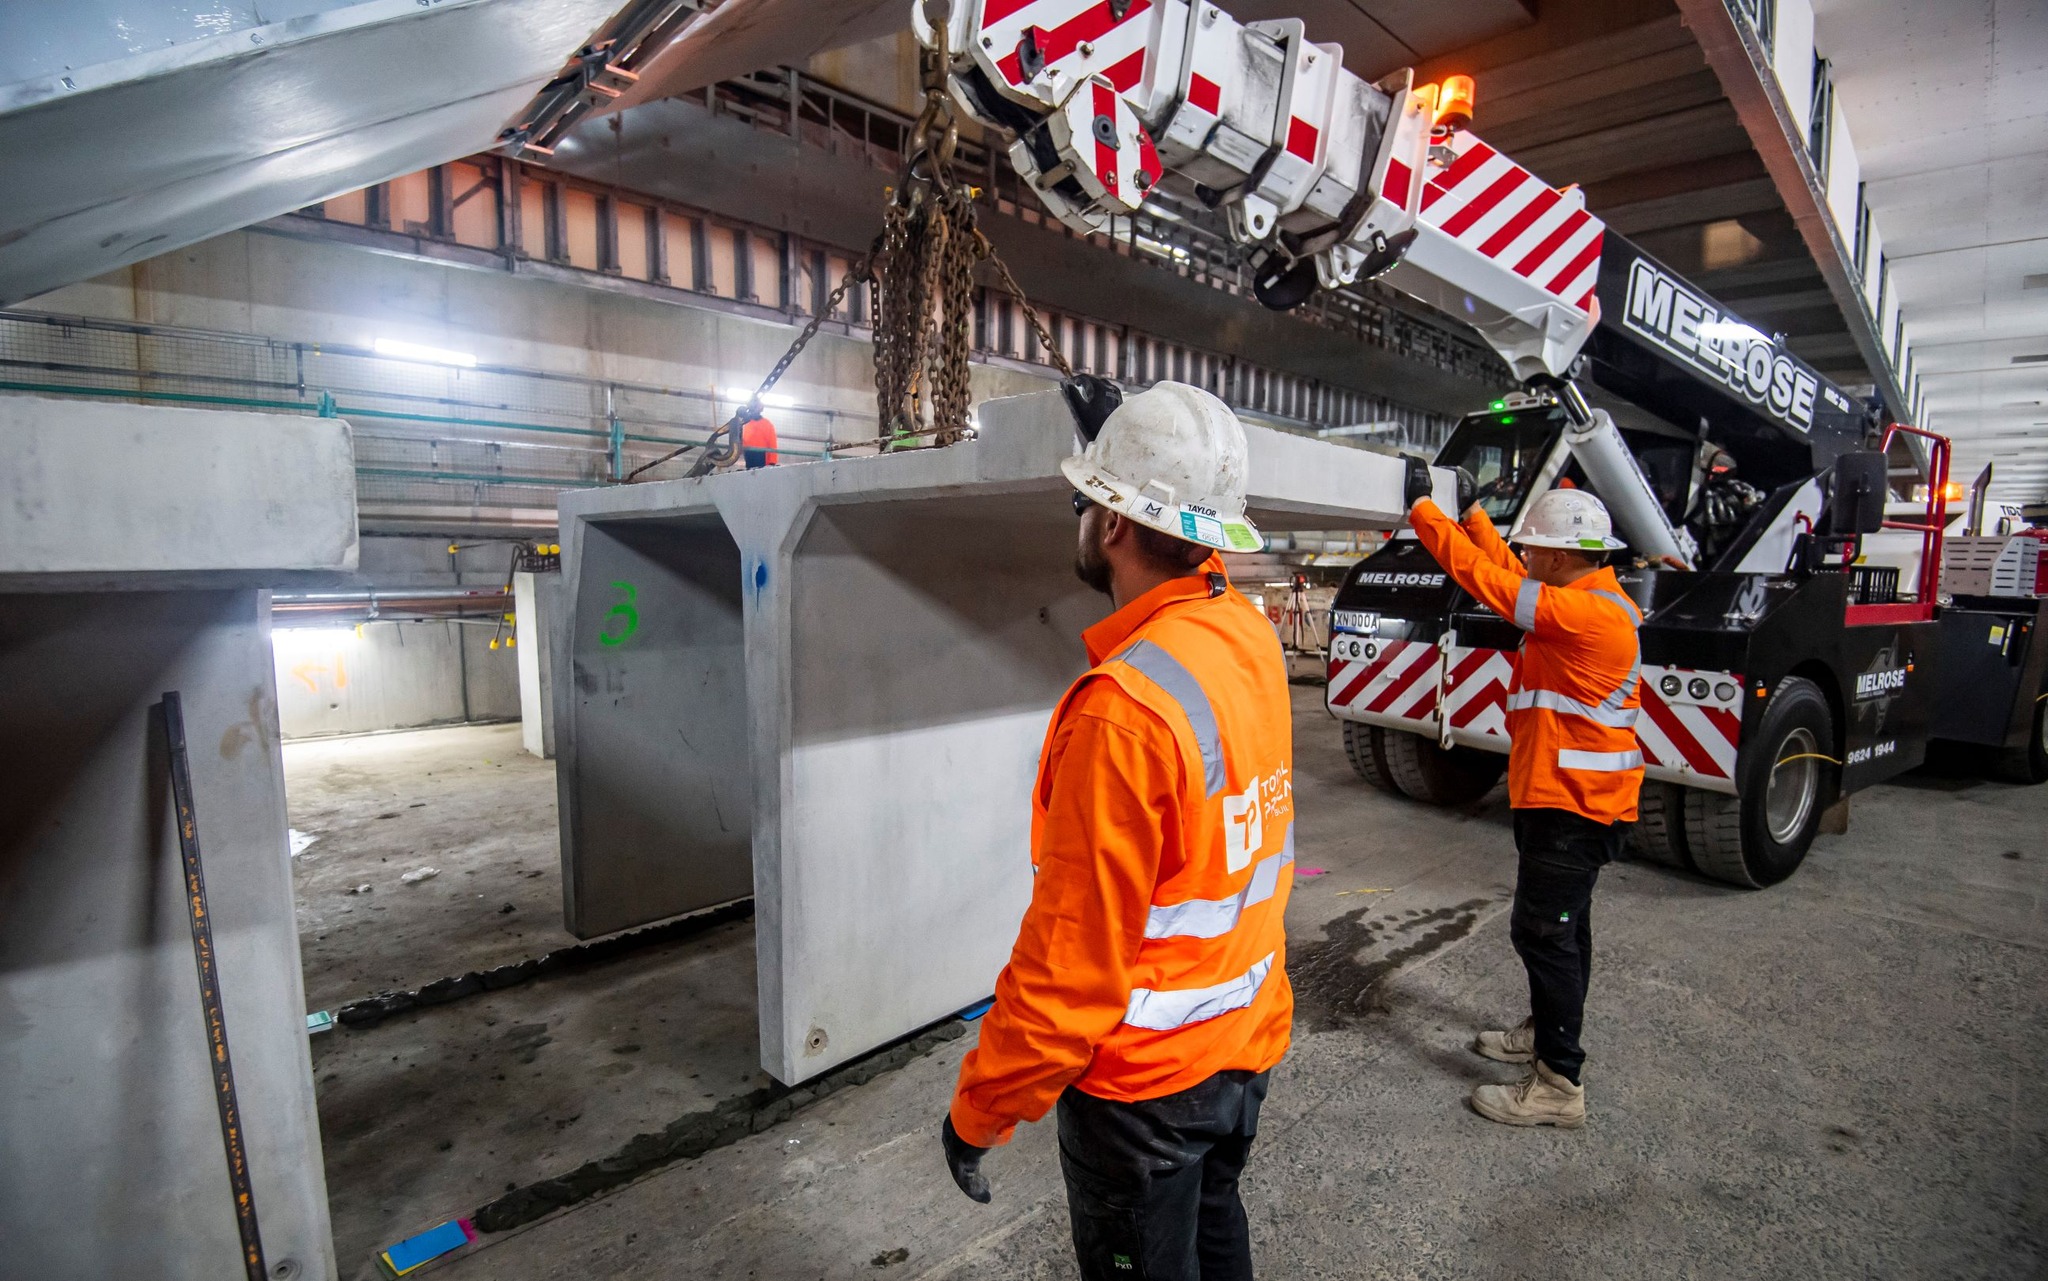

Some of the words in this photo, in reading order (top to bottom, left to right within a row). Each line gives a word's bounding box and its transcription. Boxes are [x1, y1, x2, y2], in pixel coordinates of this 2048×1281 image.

[1624, 257, 1817, 433] MELROSE
[1188, 504, 1217, 518] TAYLOR
[1358, 573, 1445, 586] MELROSE
[599, 581, 639, 647] 3
[1336, 612, 1349, 626] XN
[1857, 669, 1905, 693] MELROSE
[1848, 750, 1871, 764] 9624
[1874, 740, 1895, 756] 1944
